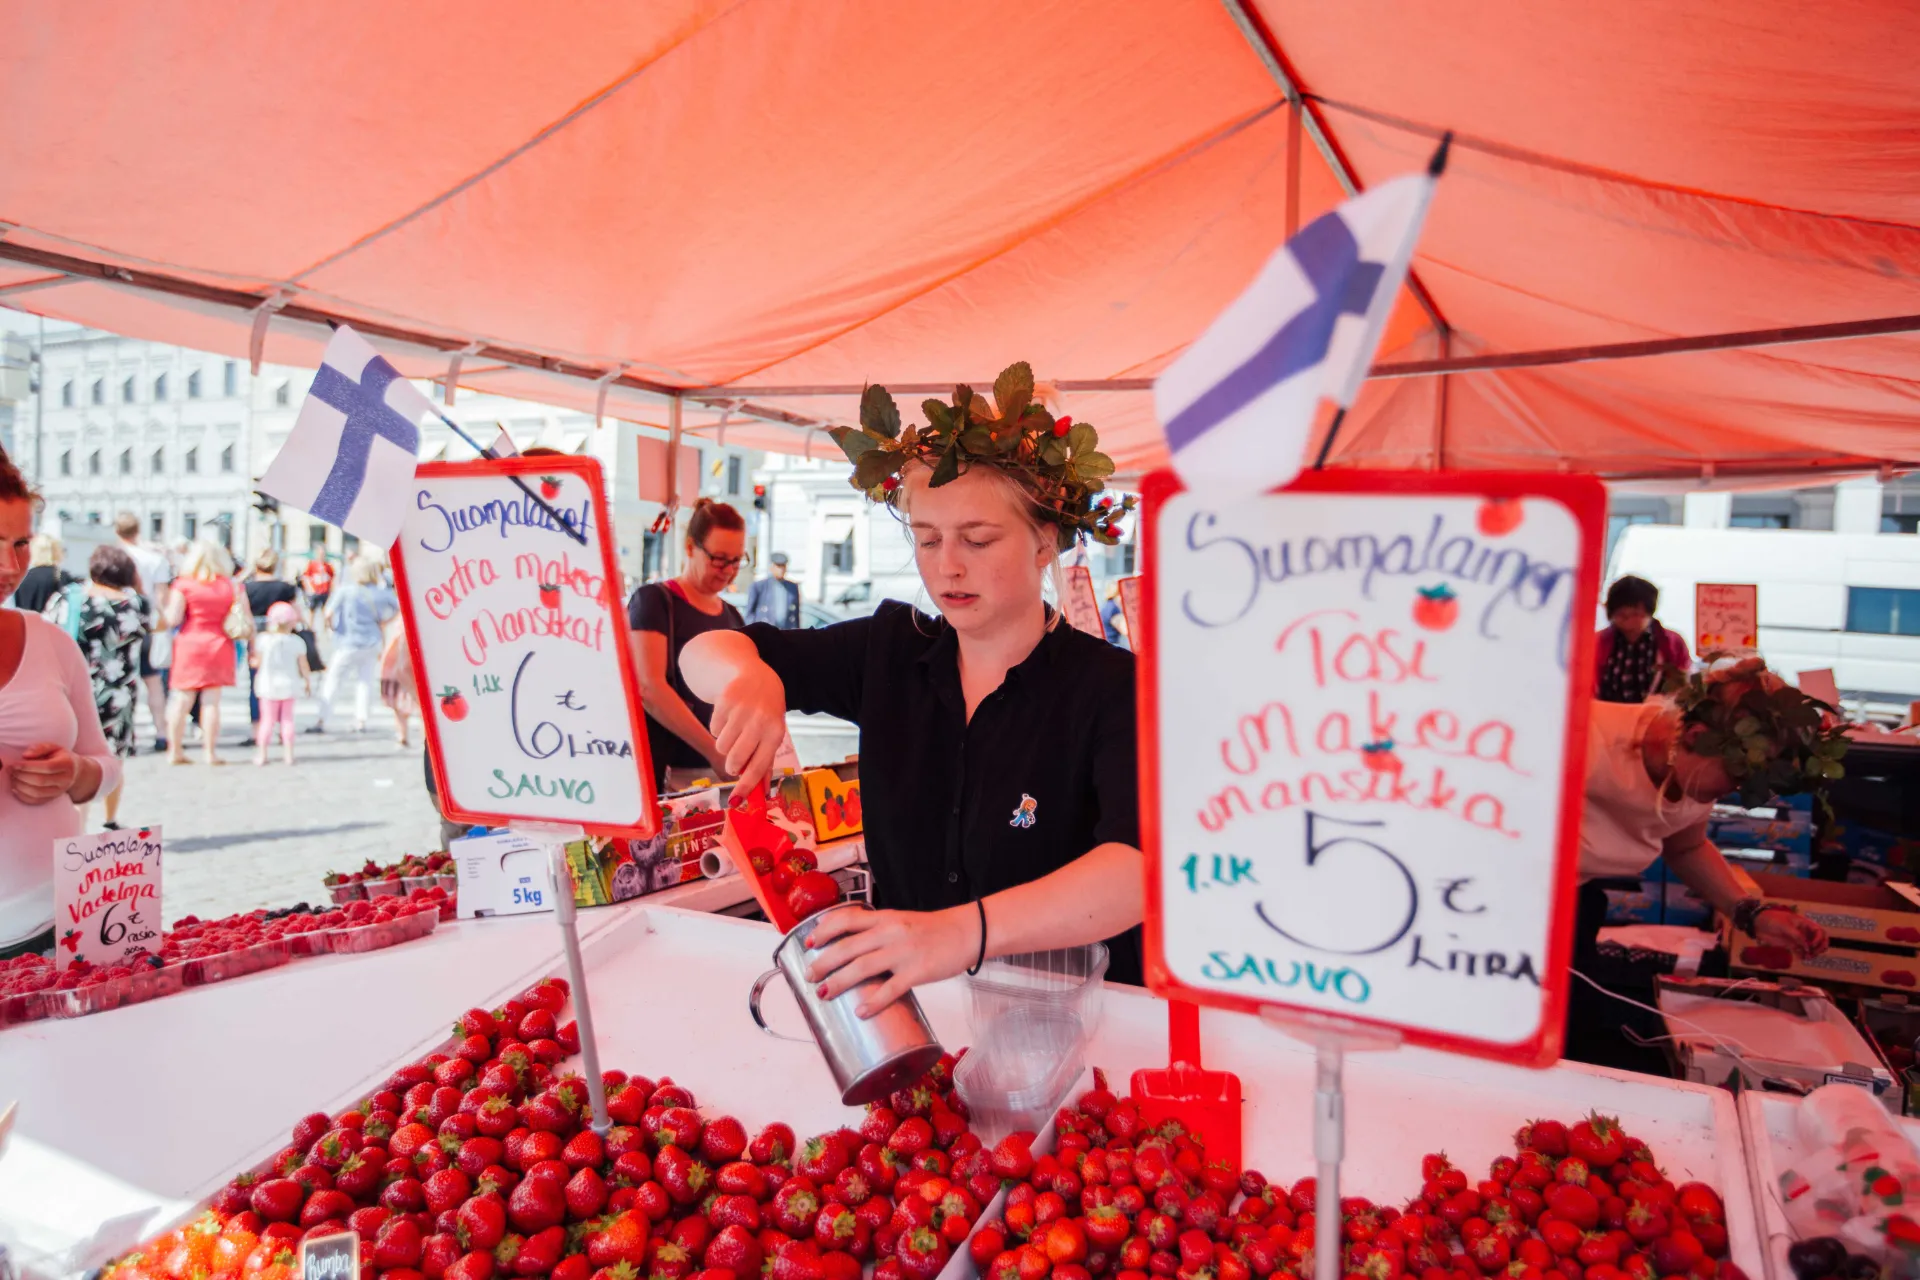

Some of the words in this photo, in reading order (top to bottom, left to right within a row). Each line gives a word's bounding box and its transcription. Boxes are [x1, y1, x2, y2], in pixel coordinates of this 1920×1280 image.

[425, 555, 499, 620] extra
[511, 651, 562, 760] 6
[488, 769, 596, 804] SAUVO
[513, 888, 522, 904] 5
[523, 888, 543, 906] kg
[1255, 810, 1418, 955] 5
[100, 903, 126, 945] 6
[128, 926, 157, 943] rasia
[1201, 951, 1370, 1004] SAUVO
